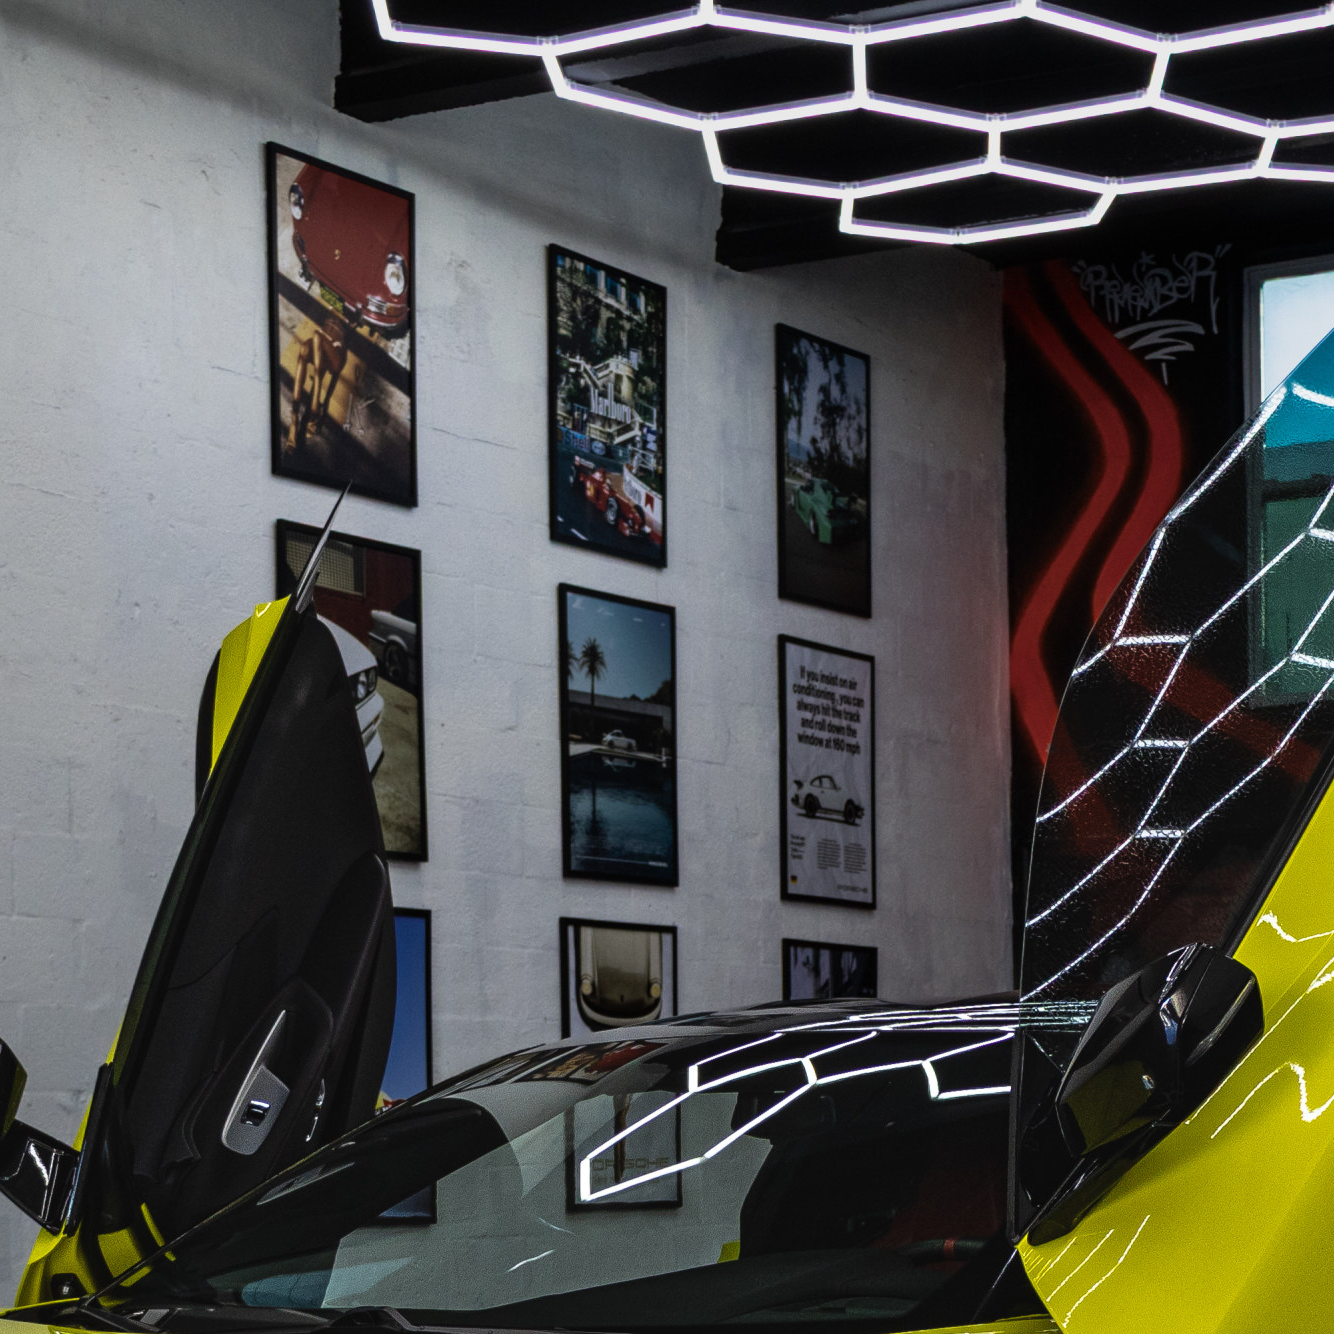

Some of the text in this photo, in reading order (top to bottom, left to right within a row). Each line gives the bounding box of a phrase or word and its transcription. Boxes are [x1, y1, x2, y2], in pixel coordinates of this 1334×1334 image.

[589, 383, 632, 424] Marlboro
[806, 669, 819, 683] you
[820, 670, 838, 686] insist
[839, 677, 848, 688] on
[848, 677, 858, 691] air
[797, 698, 861, 723] always hit the track
[839, 693, 852, 706] you
[852, 696, 865, 708] can
[801, 718, 858, 738] and roll down the
[797, 731, 824, 747] window
[824, 737, 831, 749] at
[846, 741, 861, 756] mph
[592, 1157, 670, 1171] ORSCHE
